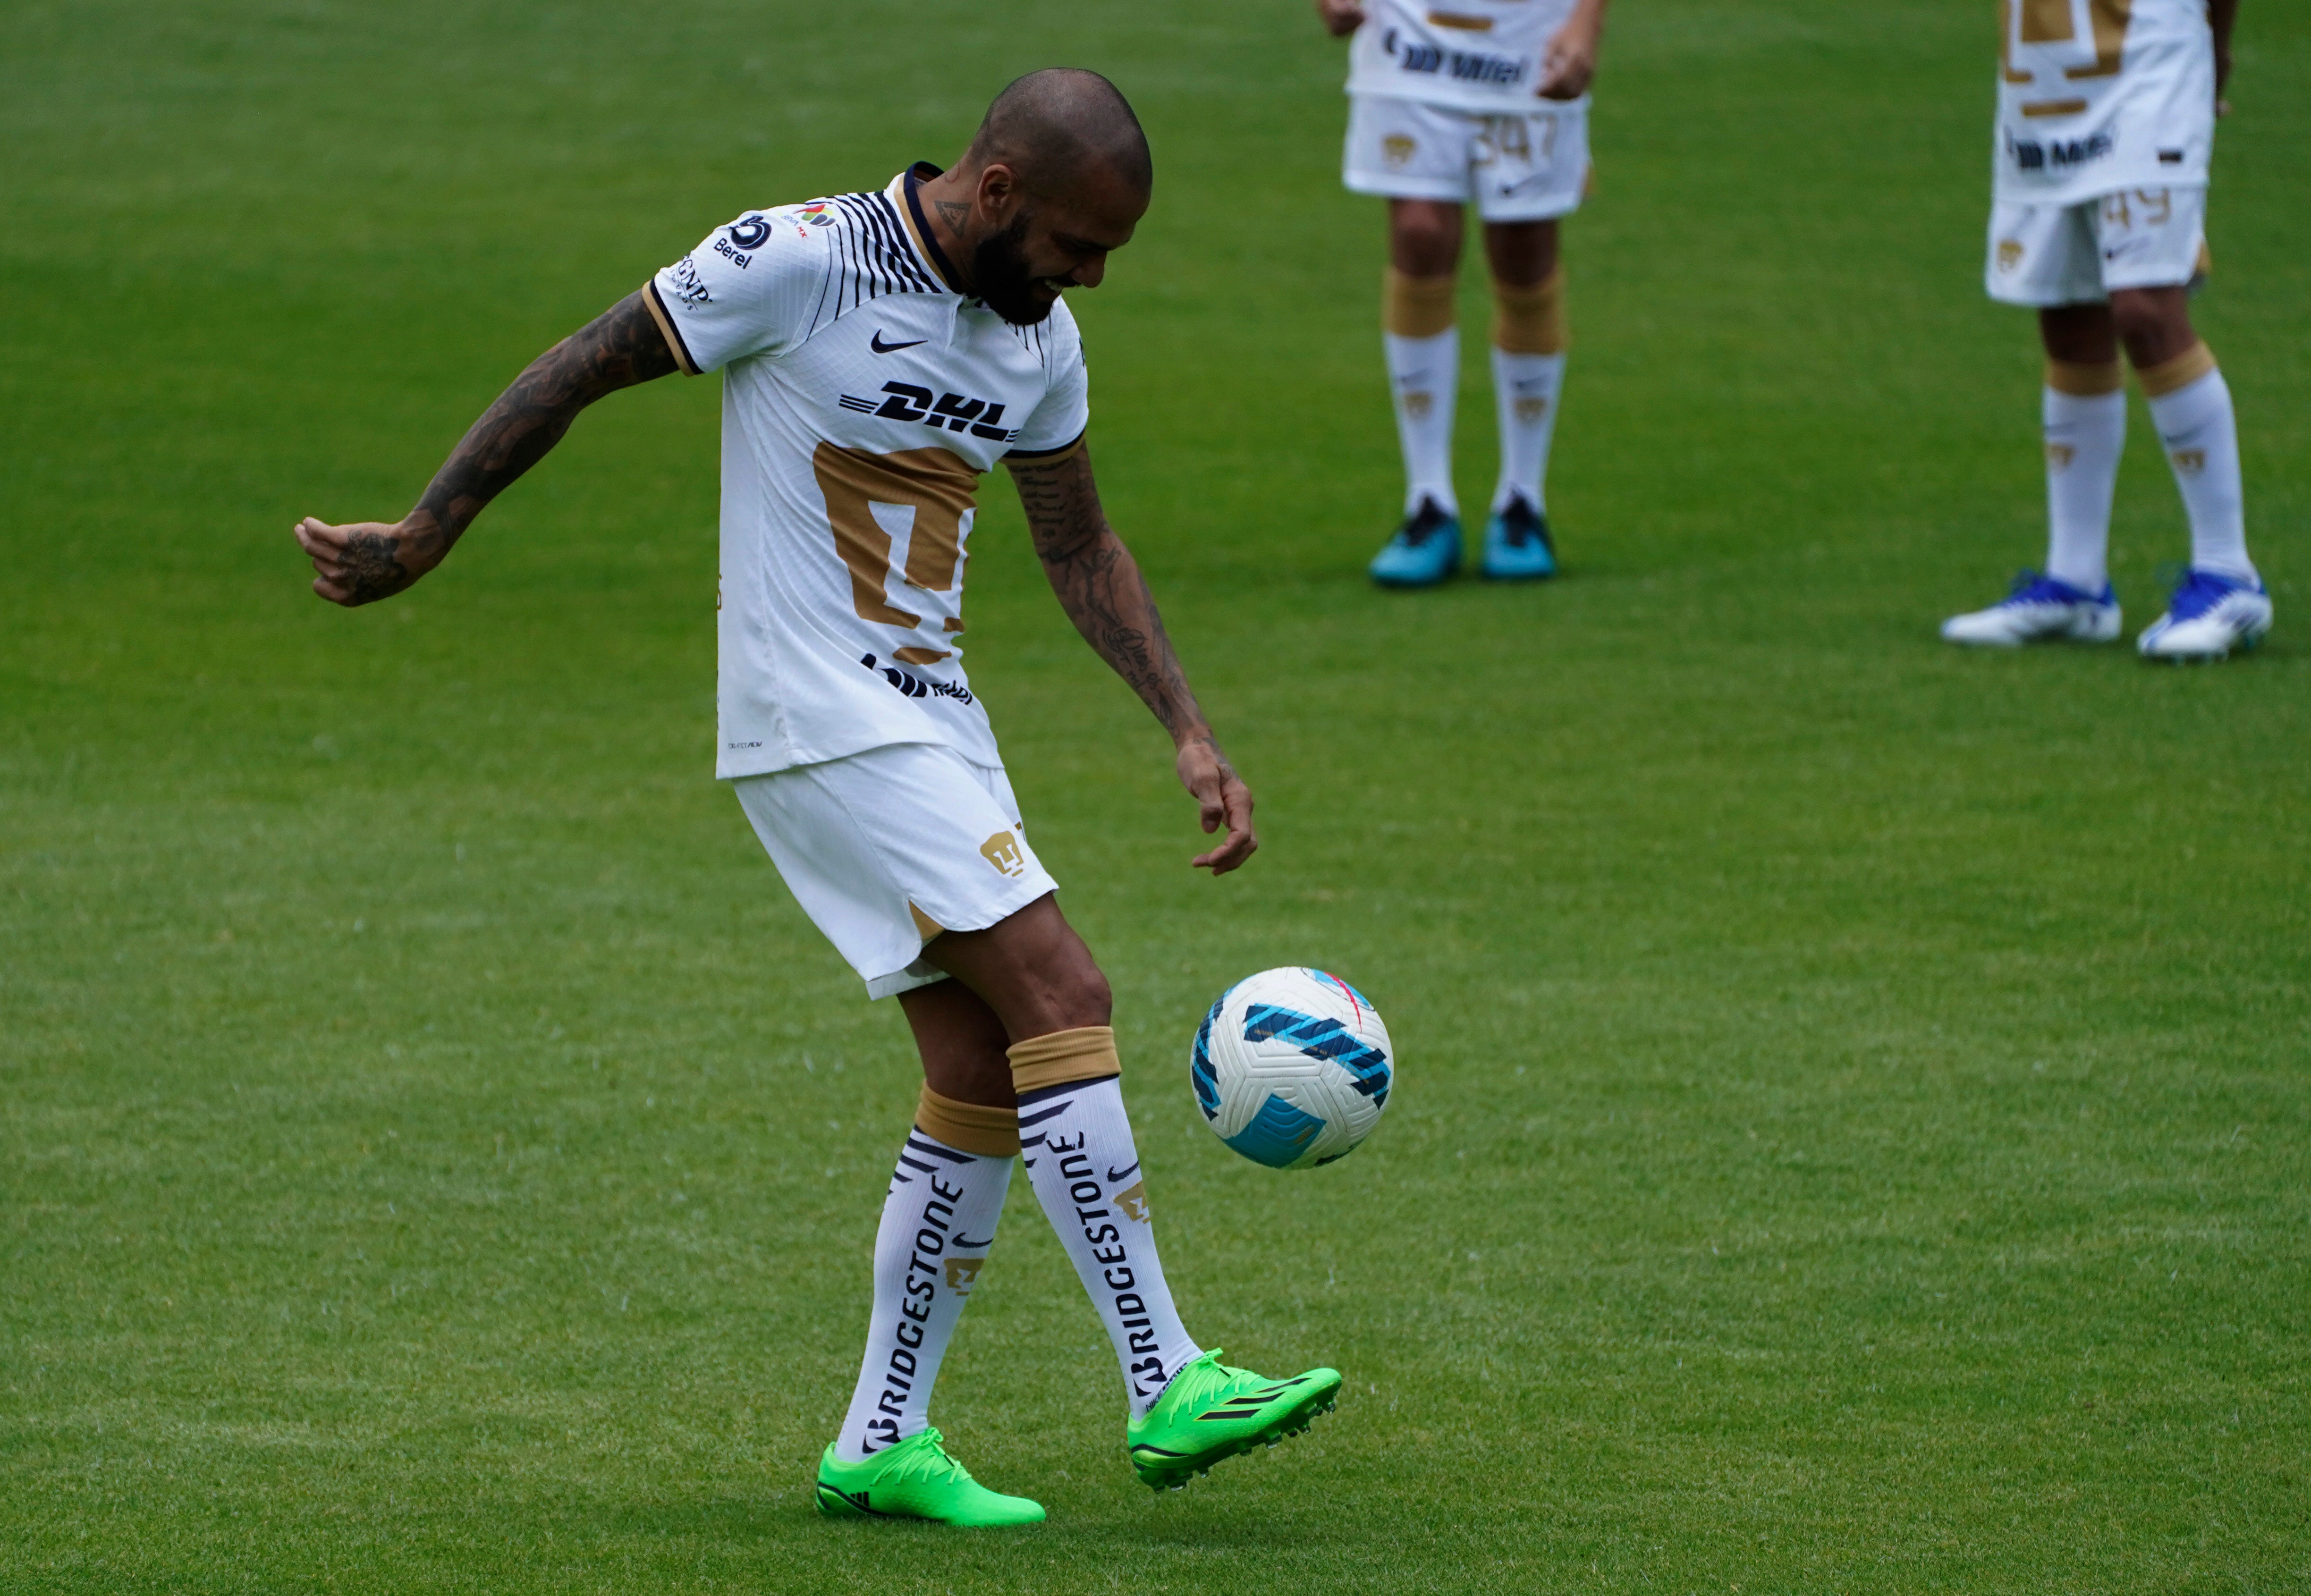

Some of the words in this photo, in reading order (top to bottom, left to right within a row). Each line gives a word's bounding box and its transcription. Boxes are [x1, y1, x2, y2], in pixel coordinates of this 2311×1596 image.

[678, 259, 709, 302] GNP
[713, 238, 752, 270] Berel
[874, 381, 1009, 442] DHL
[1046, 1131, 1168, 1397] BRIDGESTONE
[862, 1174, 964, 1454] BRIDGESTONE
